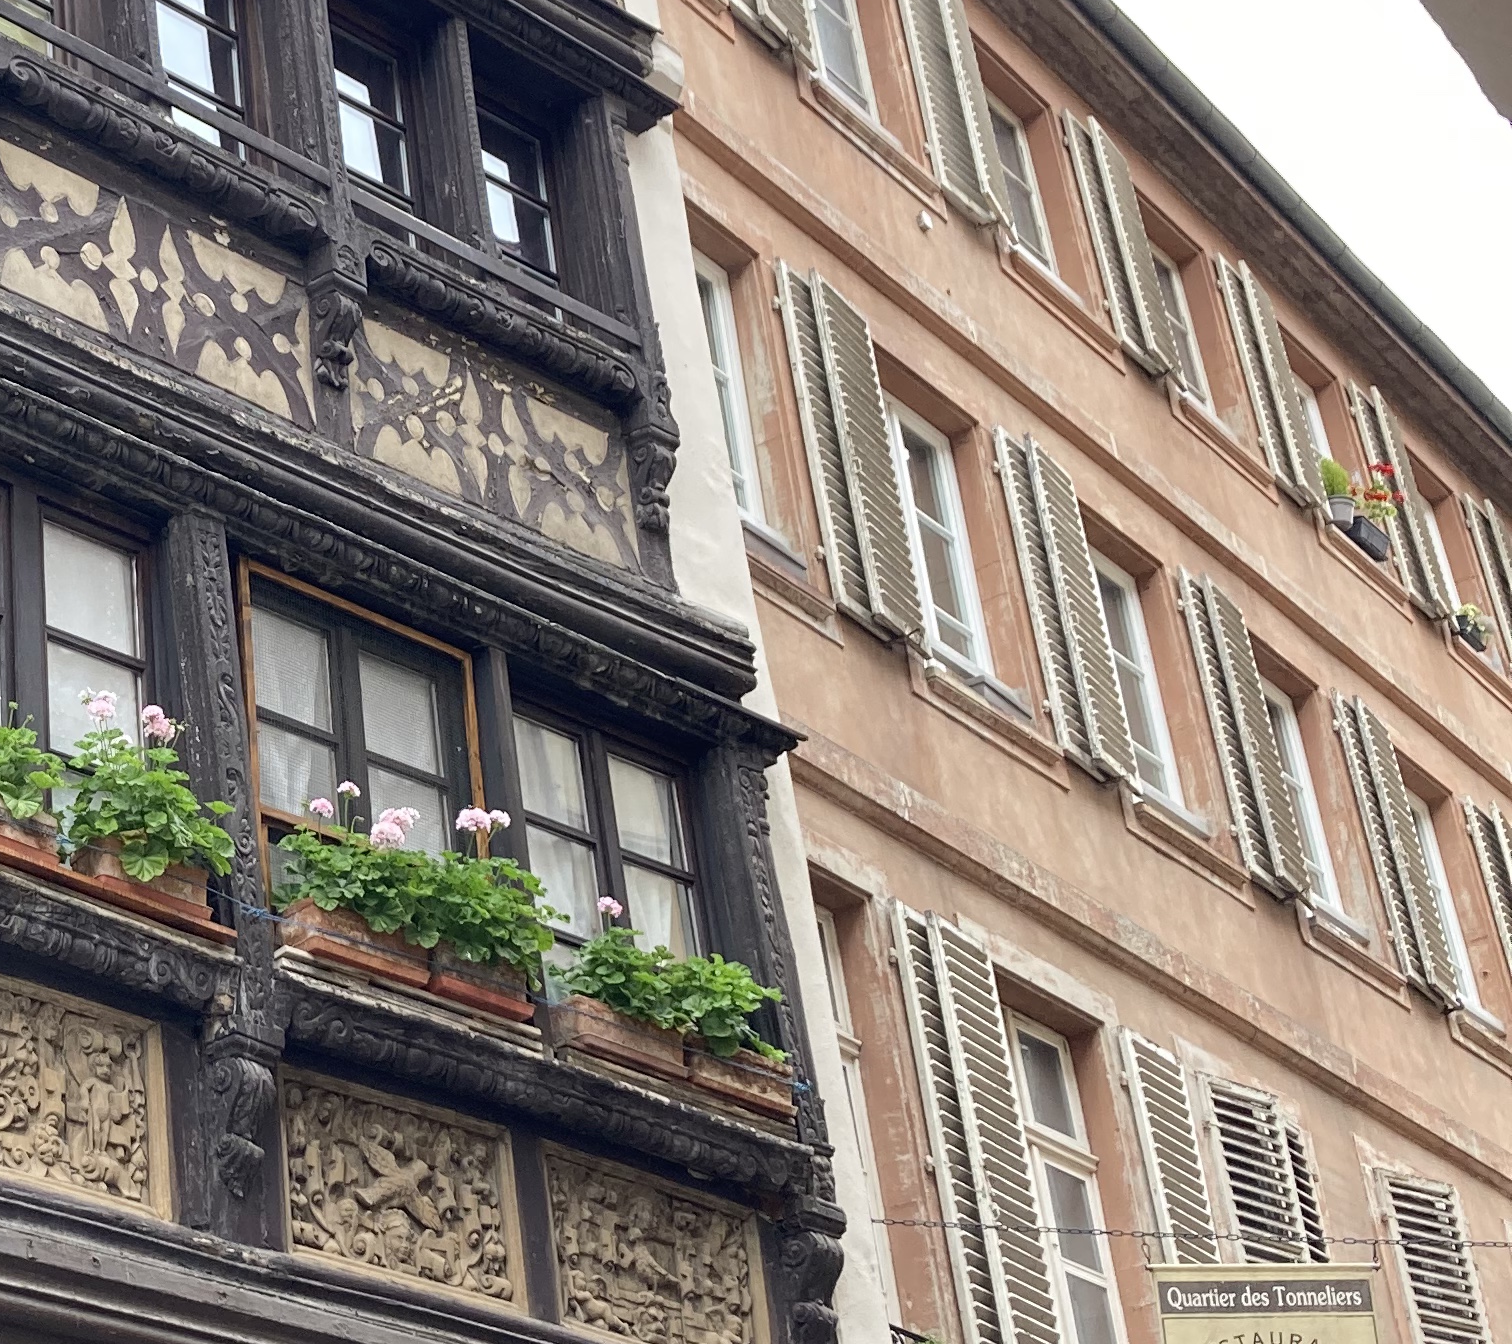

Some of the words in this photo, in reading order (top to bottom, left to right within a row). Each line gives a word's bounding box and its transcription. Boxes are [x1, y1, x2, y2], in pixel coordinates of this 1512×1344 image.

[1167, 1286, 1236, 1309] Quartier
[1241, 1286, 1270, 1308] des
[1272, 1284, 1363, 1307] Tonneliers
